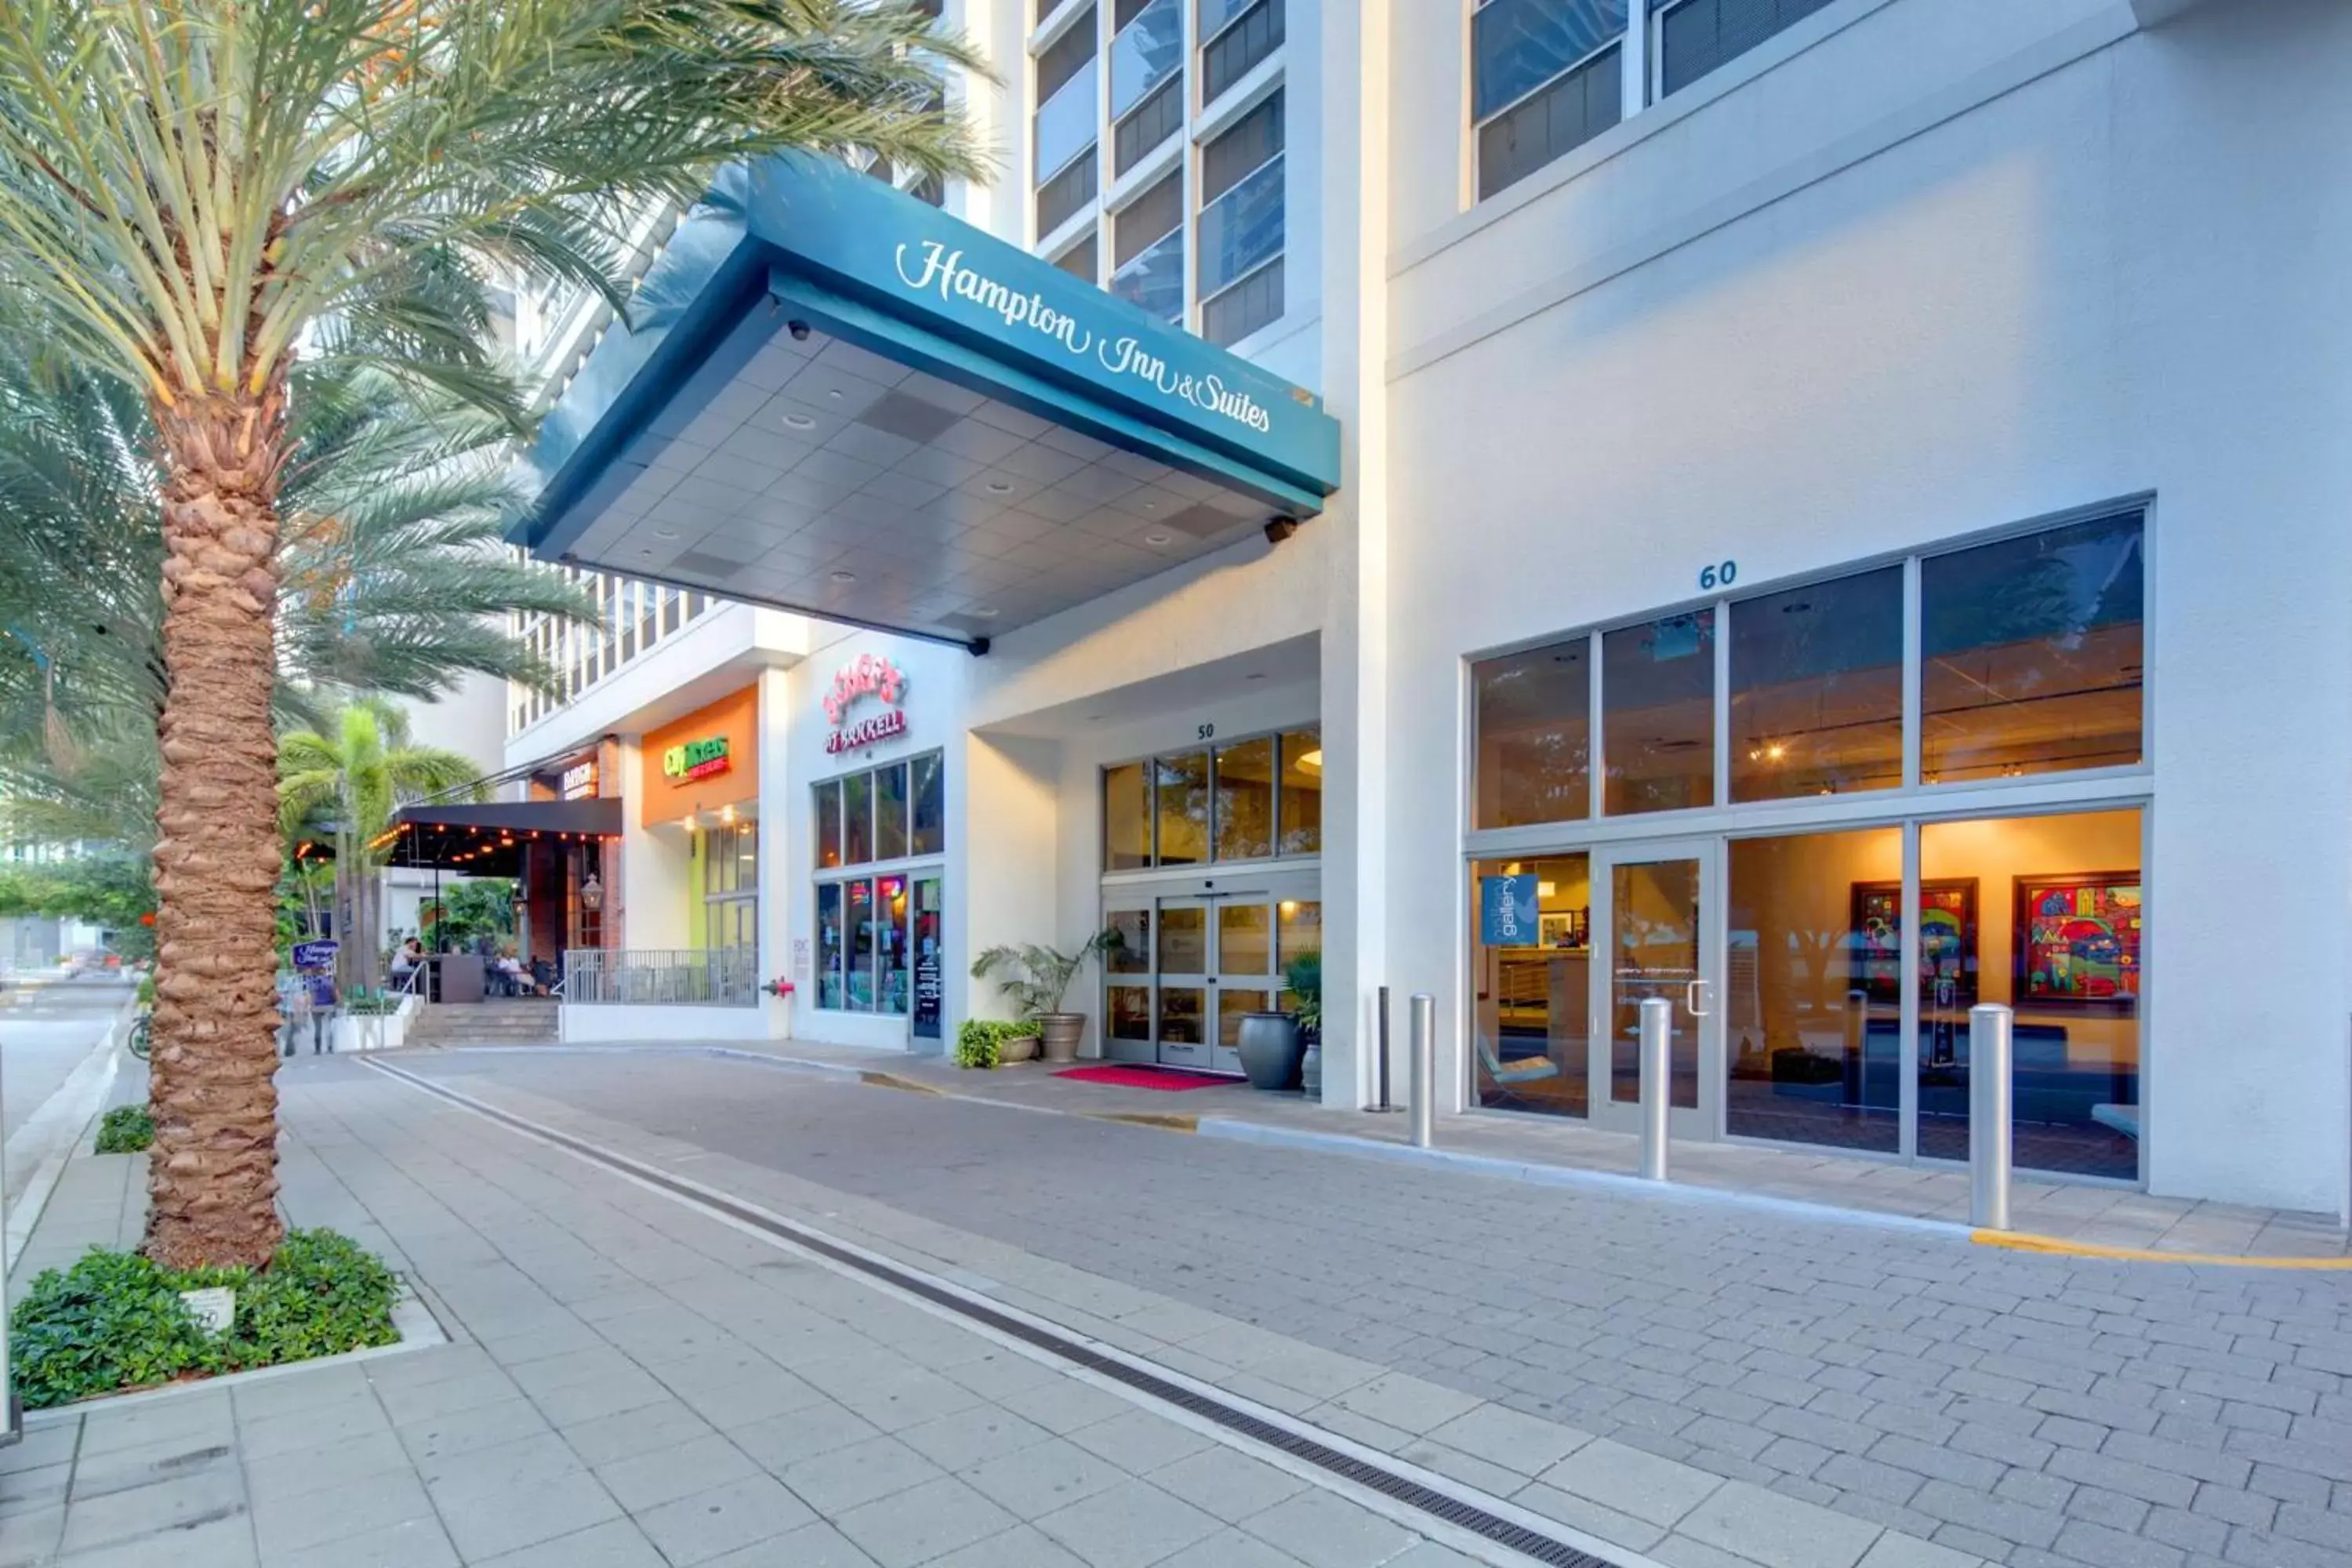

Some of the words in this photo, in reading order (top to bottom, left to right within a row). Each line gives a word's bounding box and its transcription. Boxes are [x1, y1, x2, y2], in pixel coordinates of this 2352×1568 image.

[896, 241, 1091, 354] Hampton
[1098, 338, 1179, 394] Inn
[1179, 375, 1199, 407] &
[1195, 374, 1269, 432] Suites
[1700, 561, 1736, 590] 60
[1198, 723, 1214, 740] 50
[1499, 874, 1517, 936] gallery
